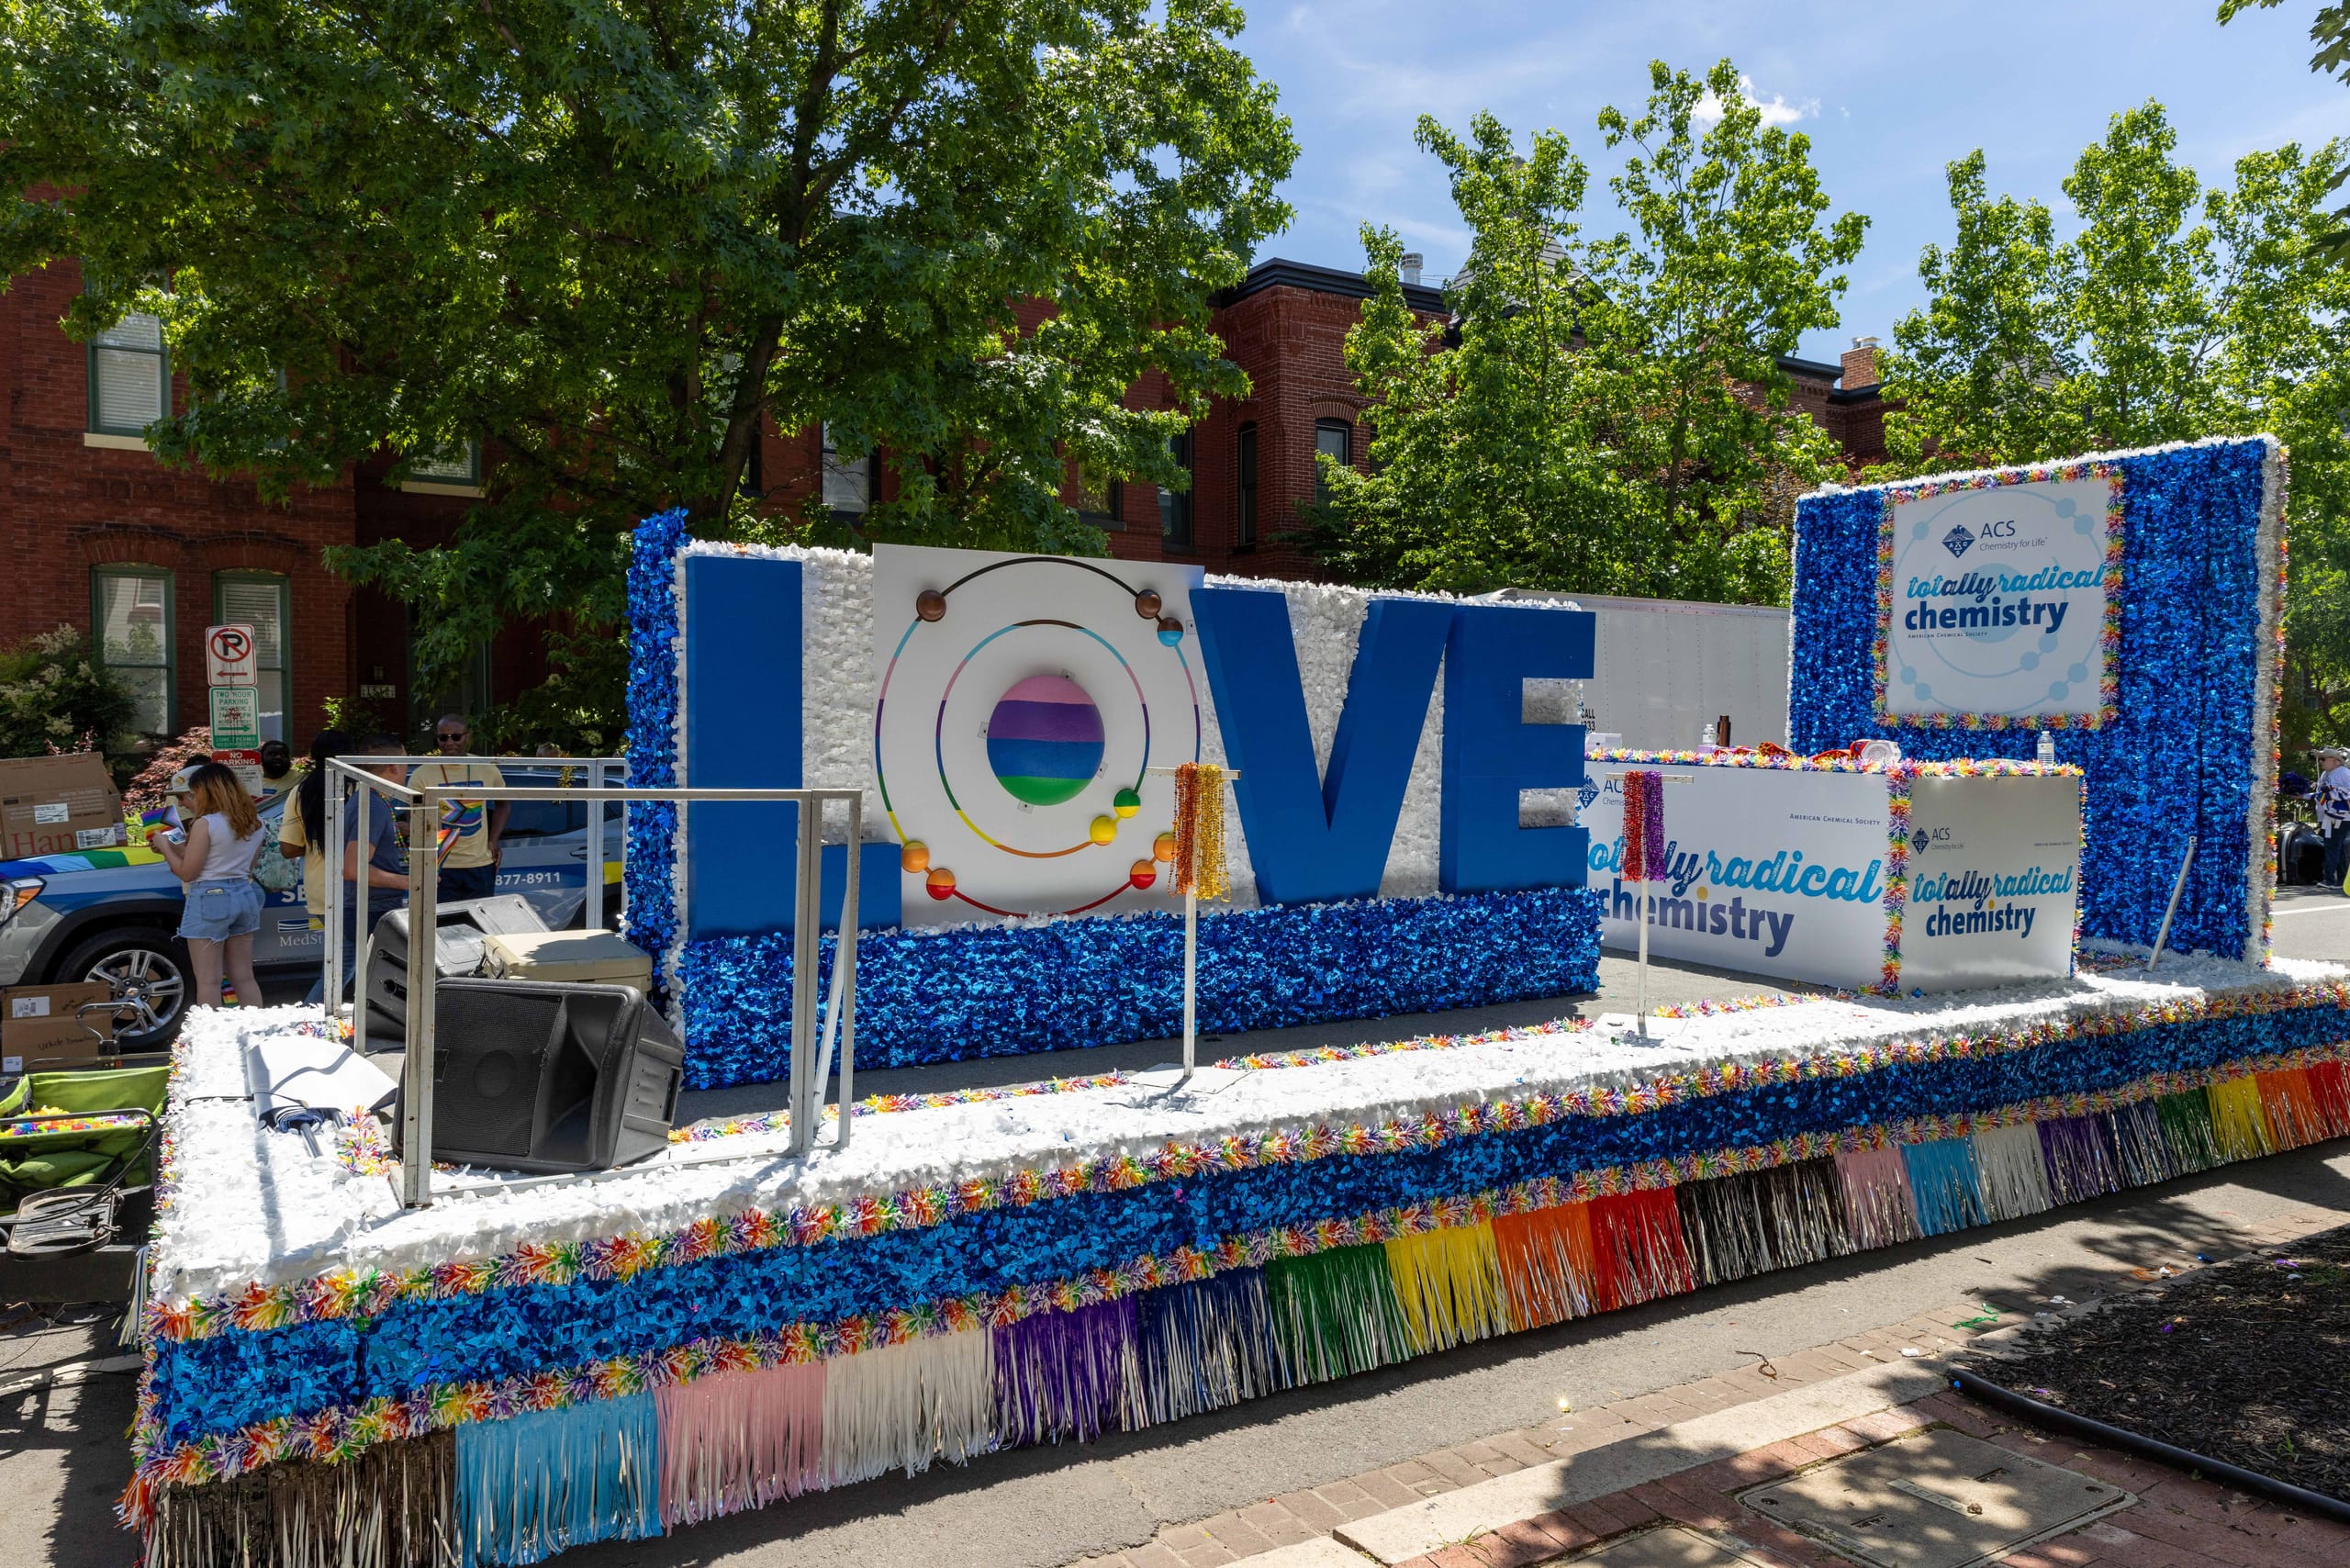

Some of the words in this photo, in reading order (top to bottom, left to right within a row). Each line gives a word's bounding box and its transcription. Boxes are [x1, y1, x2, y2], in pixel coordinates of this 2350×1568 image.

[1980, 520, 2016, 540] ACS
[1979, 540, 2020, 552] Chemistry
[2020, 539, 2030, 549] for
[1907, 572, 1998, 602] totally
[1998, 563, 2106, 593] radical
[1905, 597, 2068, 633] chemistry
[1603, 779, 1624, 793] AC
[1789, 812, 1821, 822] AMERICAN
[1822, 815, 1853, 824] CHEMICAL
[1854, 817, 1881, 826] SOCIETY
[1931, 827, 1951, 841] ACS
[495, 872, 561, 886] 877-8911
[1587, 836, 1703, 897] otly
[1706, 846, 1885, 904] radical
[1912, 869, 1992, 910] totally
[1993, 865, 2073, 897] radical
[1597, 878, 1794, 958] chemistry
[1926, 900, 2036, 938] chemistry
[1903, 1484, 1964, 1510] PEPCO
